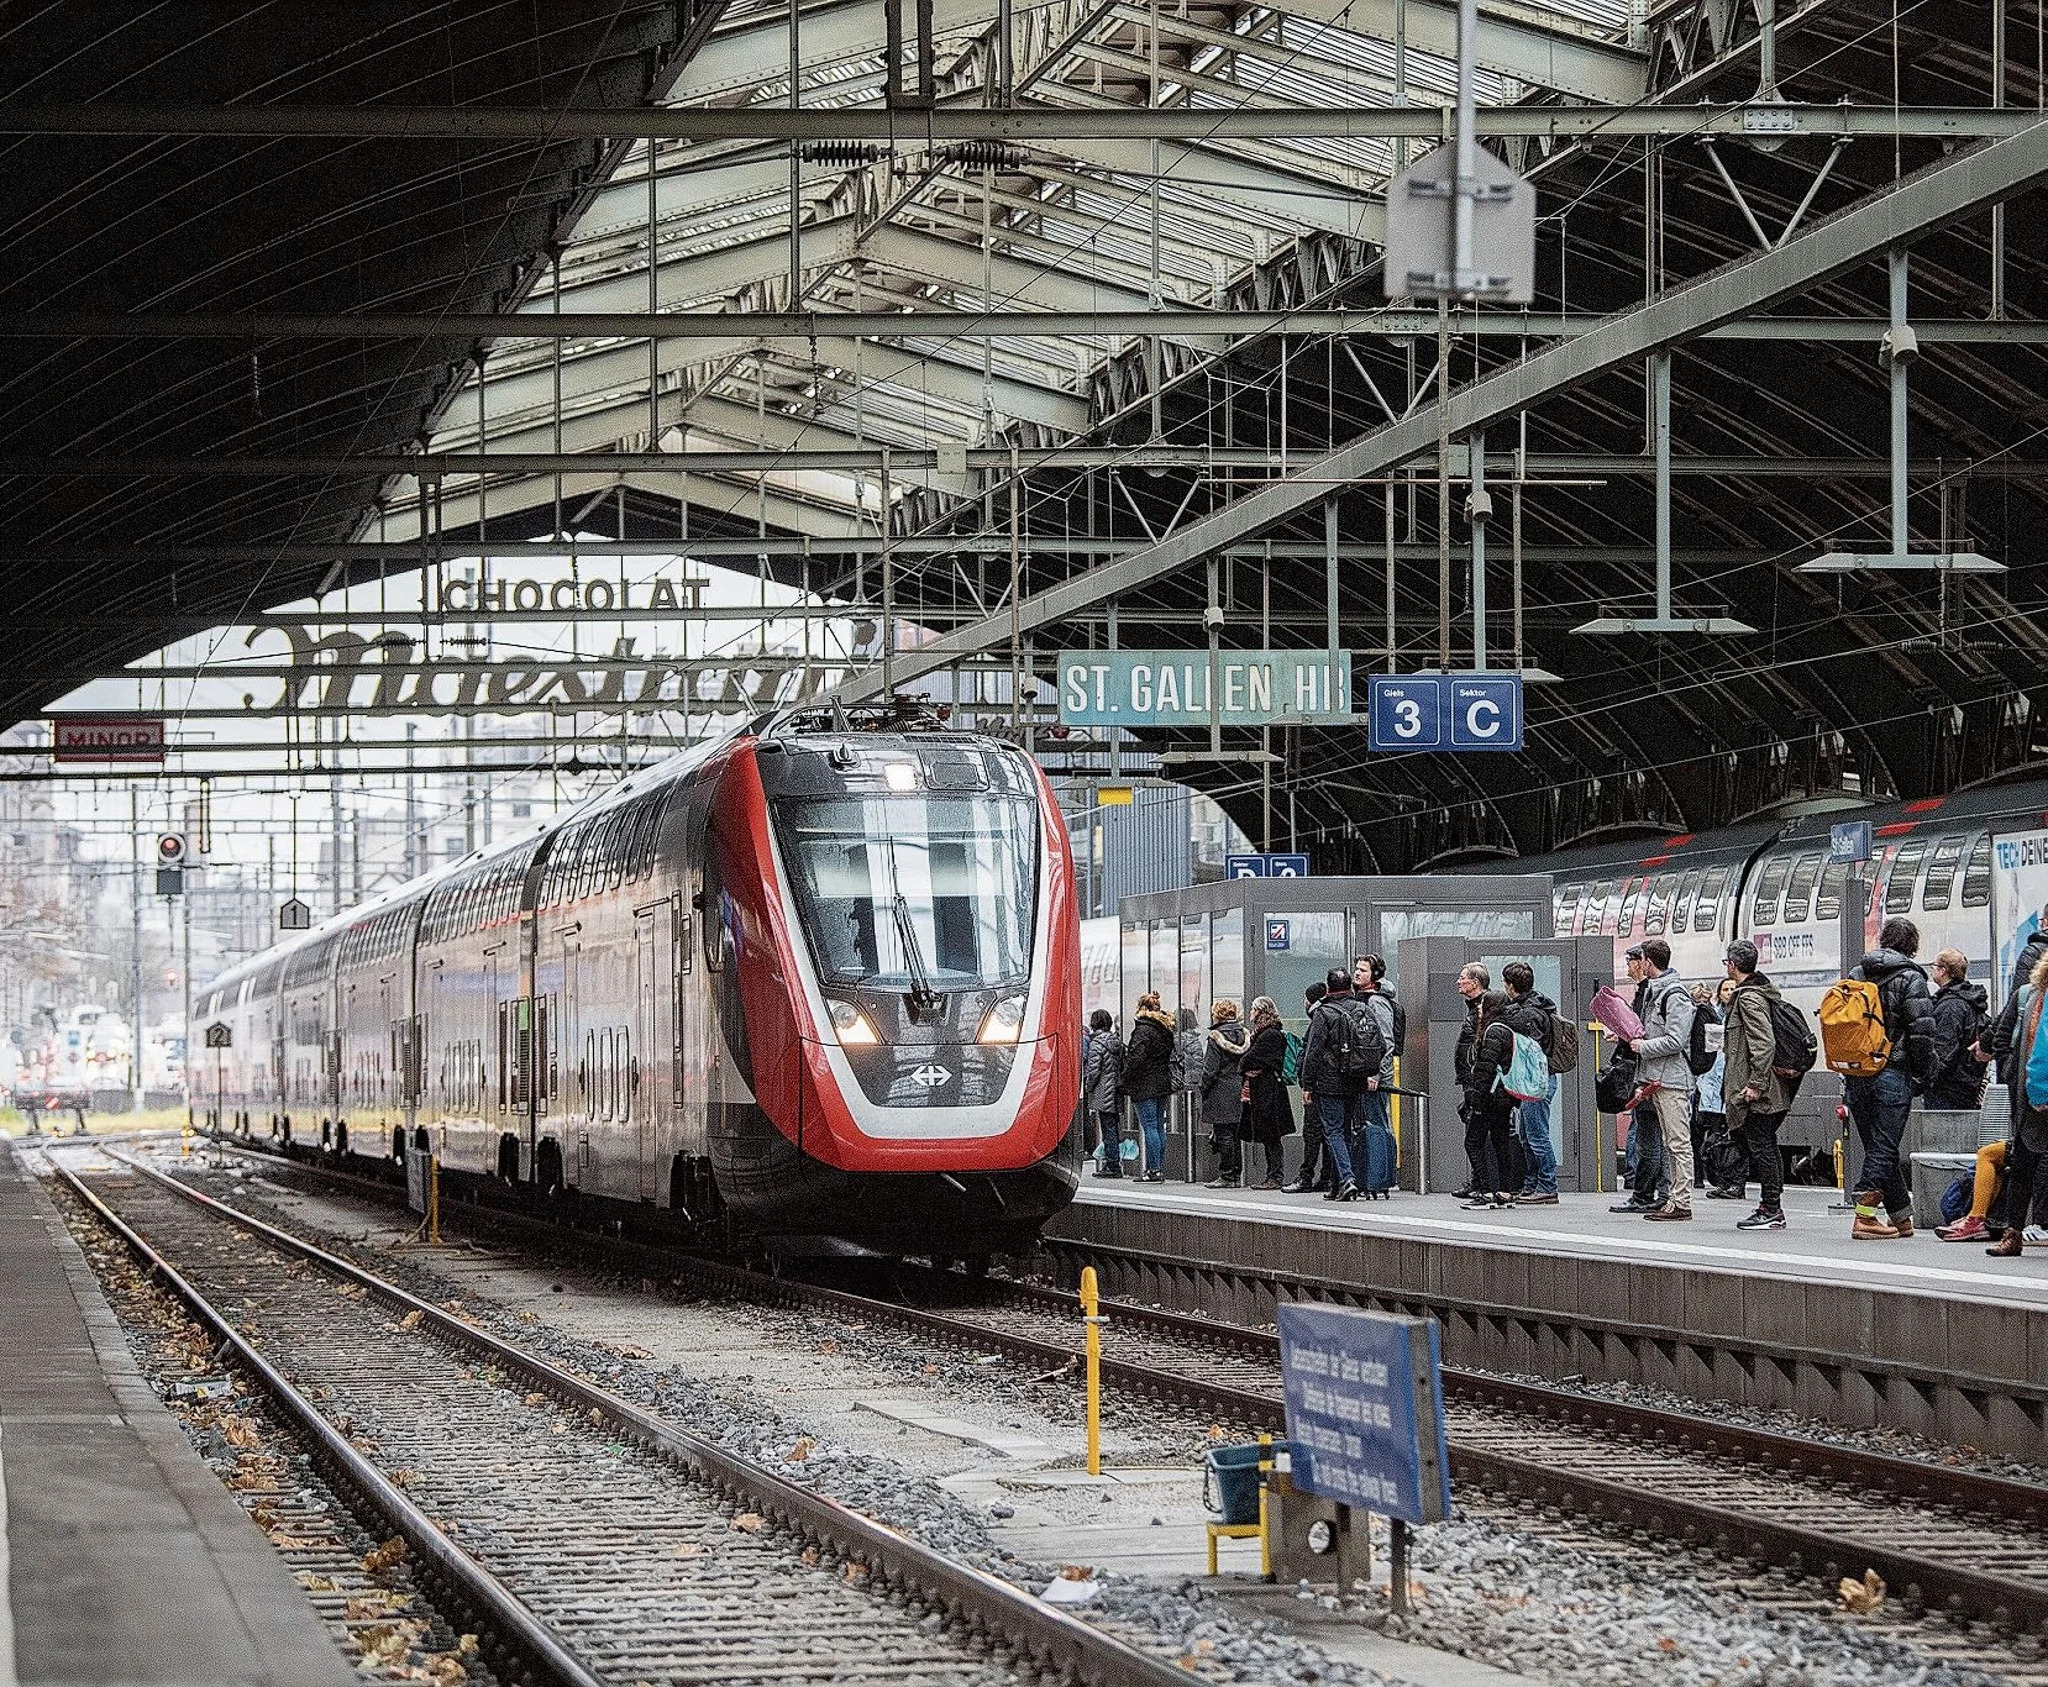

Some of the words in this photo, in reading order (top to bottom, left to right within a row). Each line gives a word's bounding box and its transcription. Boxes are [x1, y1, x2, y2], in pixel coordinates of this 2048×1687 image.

[444, 578, 709, 611] CHOCOLAT
[1066, 664, 1119, 712] ST.
[1130, 664, 1271, 712] GALLEN
[1459, 689, 1487, 697] Sektor
[1394, 700, 1421, 738] 3
[1466, 700, 1500, 738] C
[290, 905, 297, 926] 1
